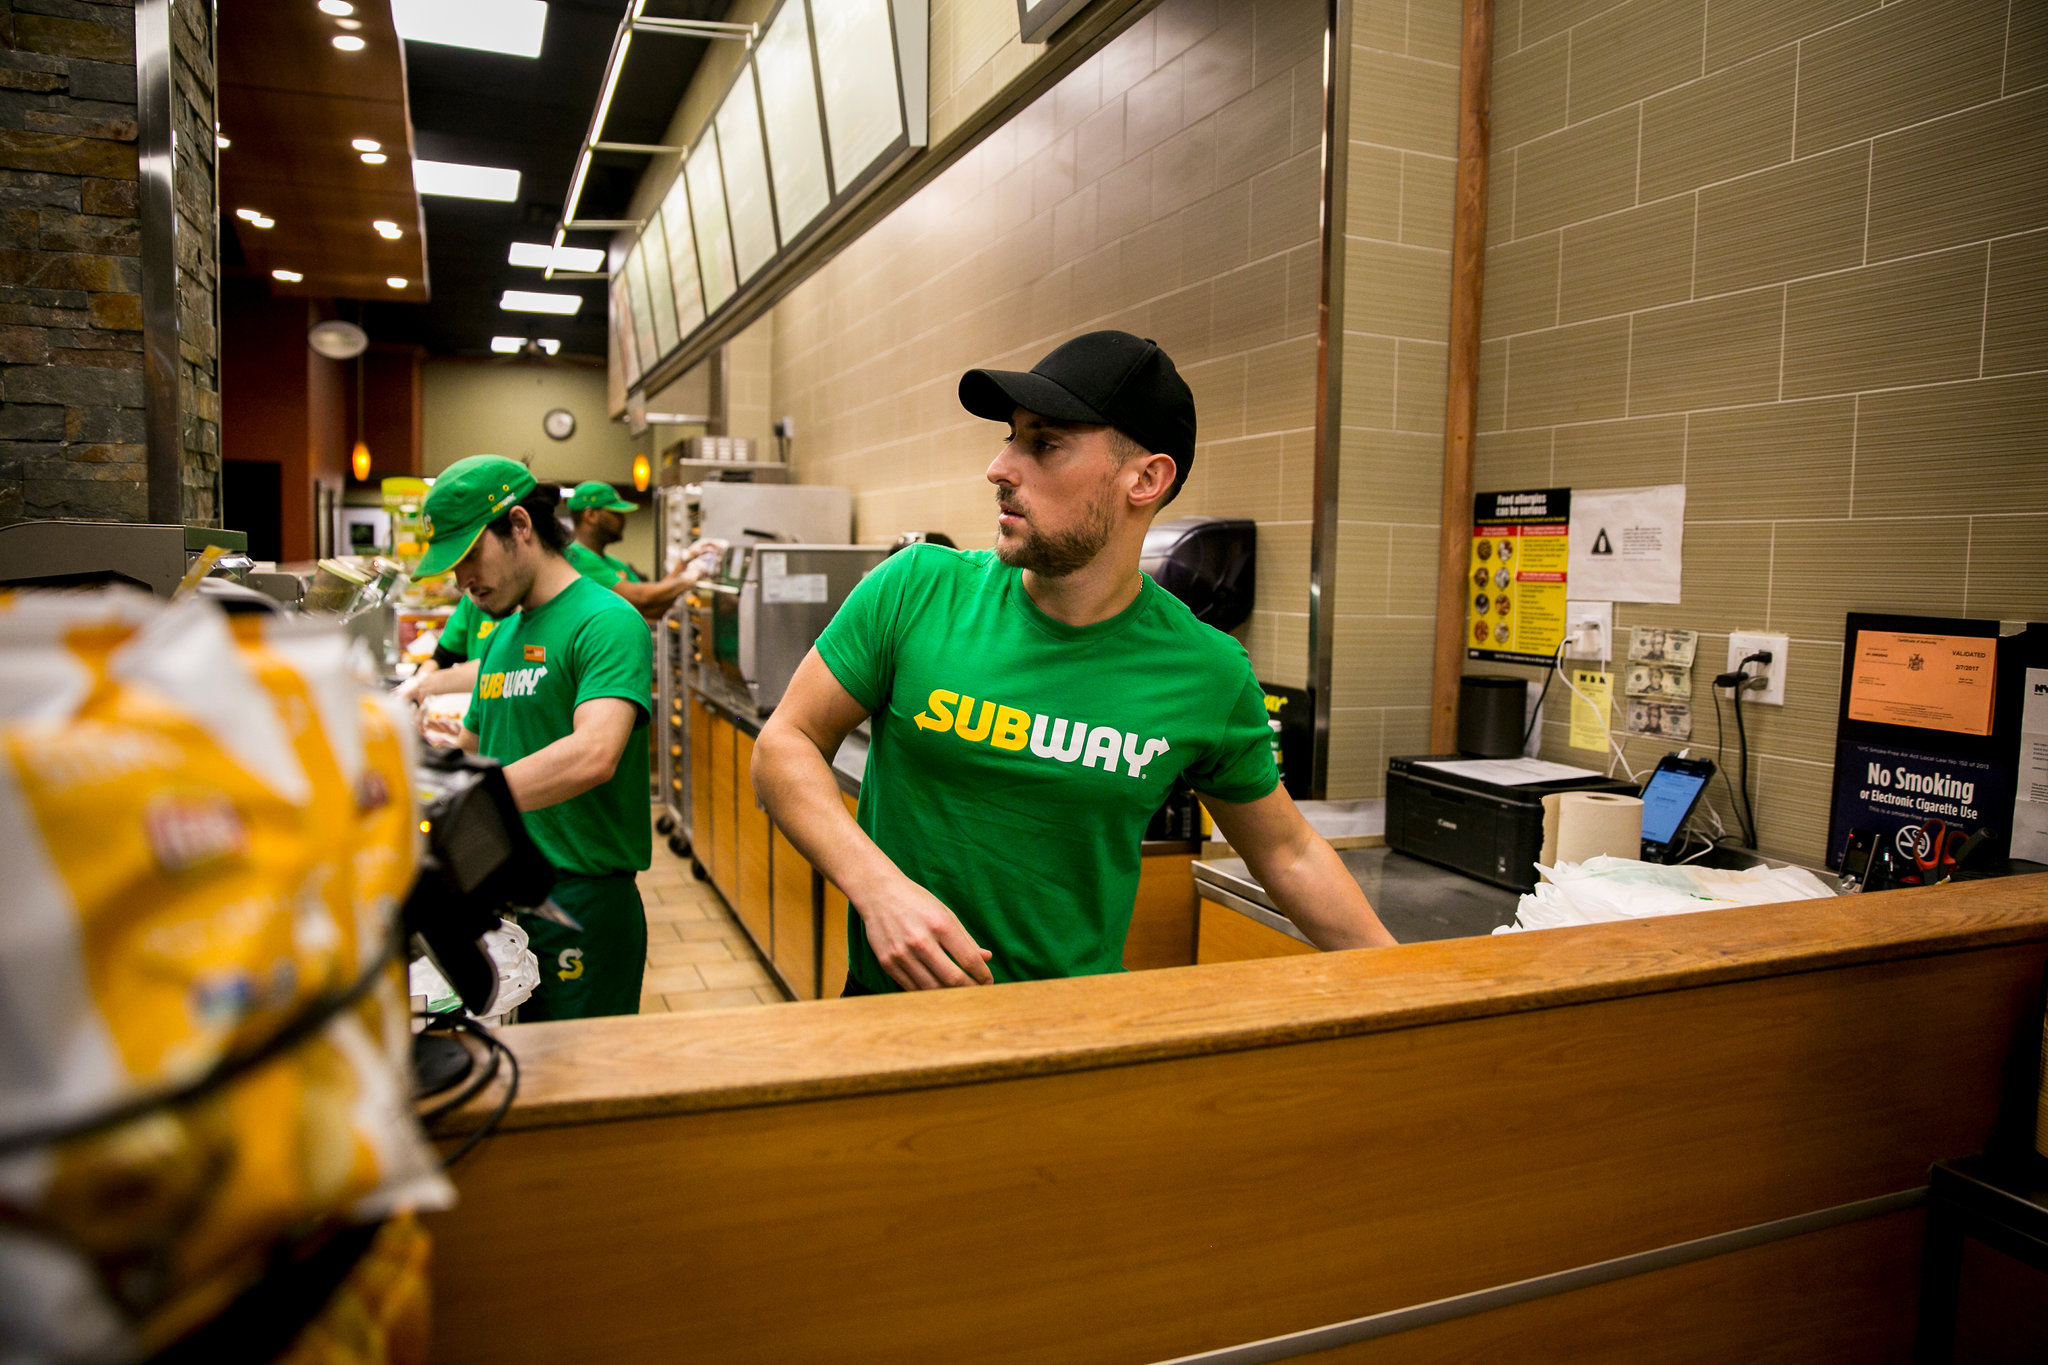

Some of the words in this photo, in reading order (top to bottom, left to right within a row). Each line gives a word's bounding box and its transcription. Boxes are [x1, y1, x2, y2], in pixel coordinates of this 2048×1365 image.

[1952, 650, 1986, 659] VALIDATED
[1955, 664, 1980, 672] 2/7/2017
[913, 689, 1170, 778] SUBWAY
[1867, 762, 1891, 787] No
[1895, 767, 1975, 805] Smoking
[1860, 790, 1870, 800] or
[1871, 789, 1914, 808] Electronic
[1916, 798, 1958, 816] Cigarette
[1960, 805, 1978, 820] Use
[1437, 818, 1457, 830] Canon
